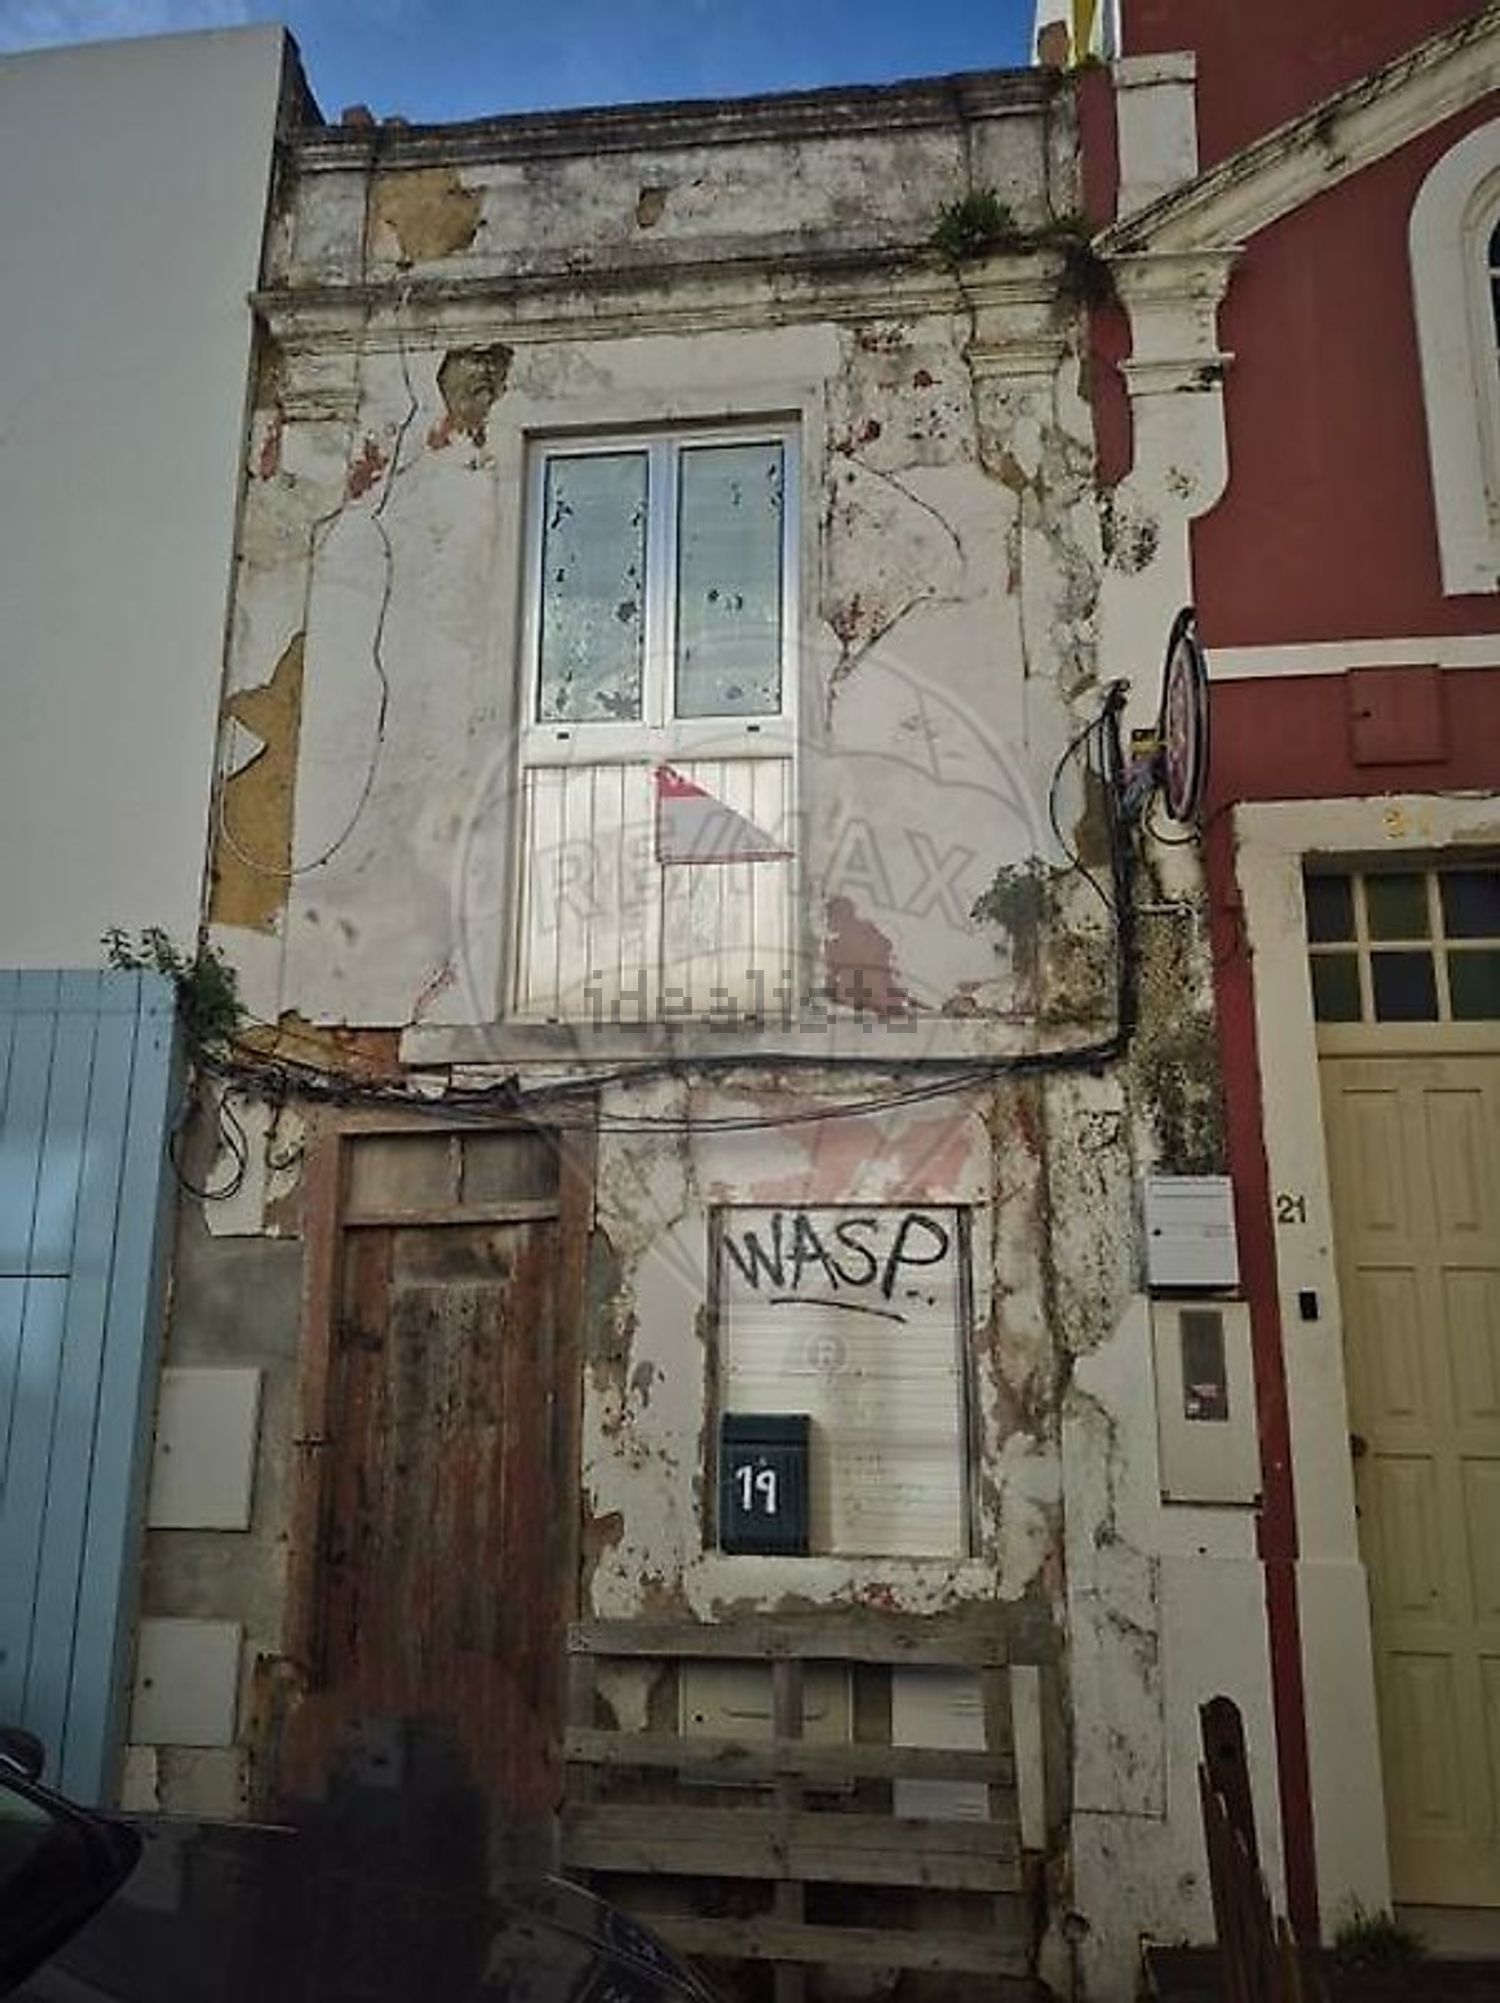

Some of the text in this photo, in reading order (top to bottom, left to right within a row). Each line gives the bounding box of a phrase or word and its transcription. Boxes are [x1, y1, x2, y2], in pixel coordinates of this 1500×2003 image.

[1276, 1194, 1307, 1224] 21
[724, 1212, 950, 1300] WASP
[736, 1465, 777, 1514] 19
